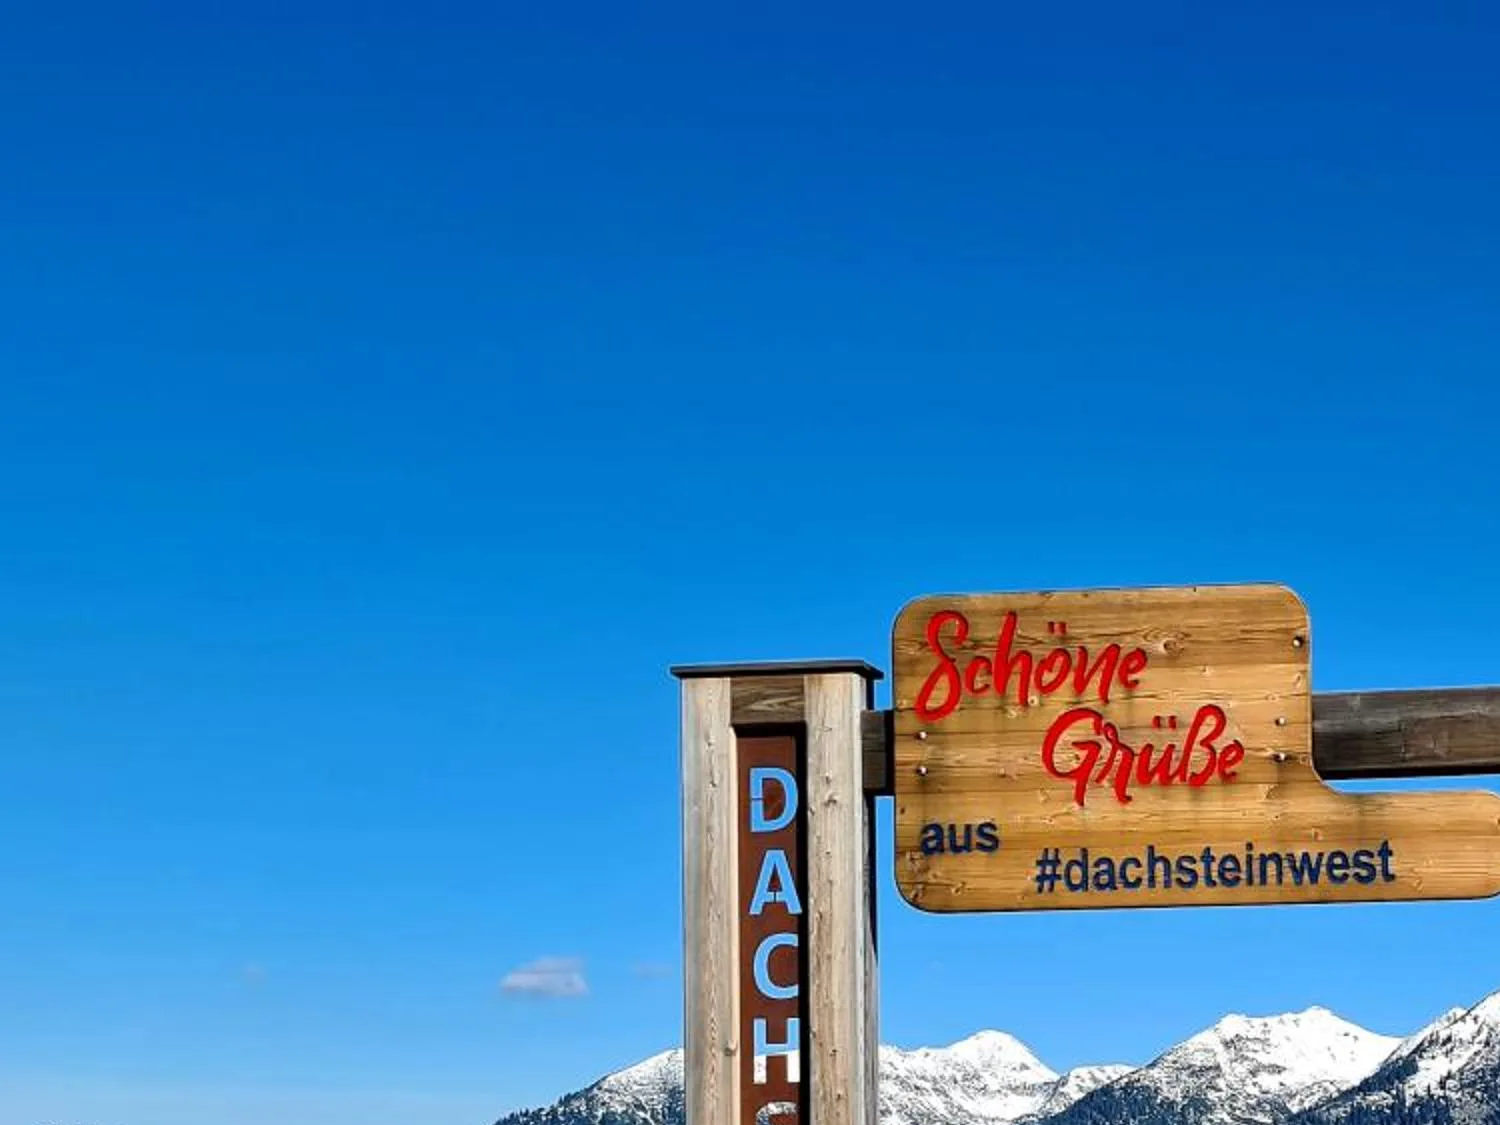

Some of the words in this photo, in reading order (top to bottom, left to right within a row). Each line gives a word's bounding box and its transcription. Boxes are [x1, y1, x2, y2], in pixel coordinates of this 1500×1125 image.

[916, 611, 1148, 721] Schöne
[1042, 705, 1245, 805] Grüße
[920, 821, 1000, 855] aus
[1035, 840, 1395, 893] #dachsteinwest
